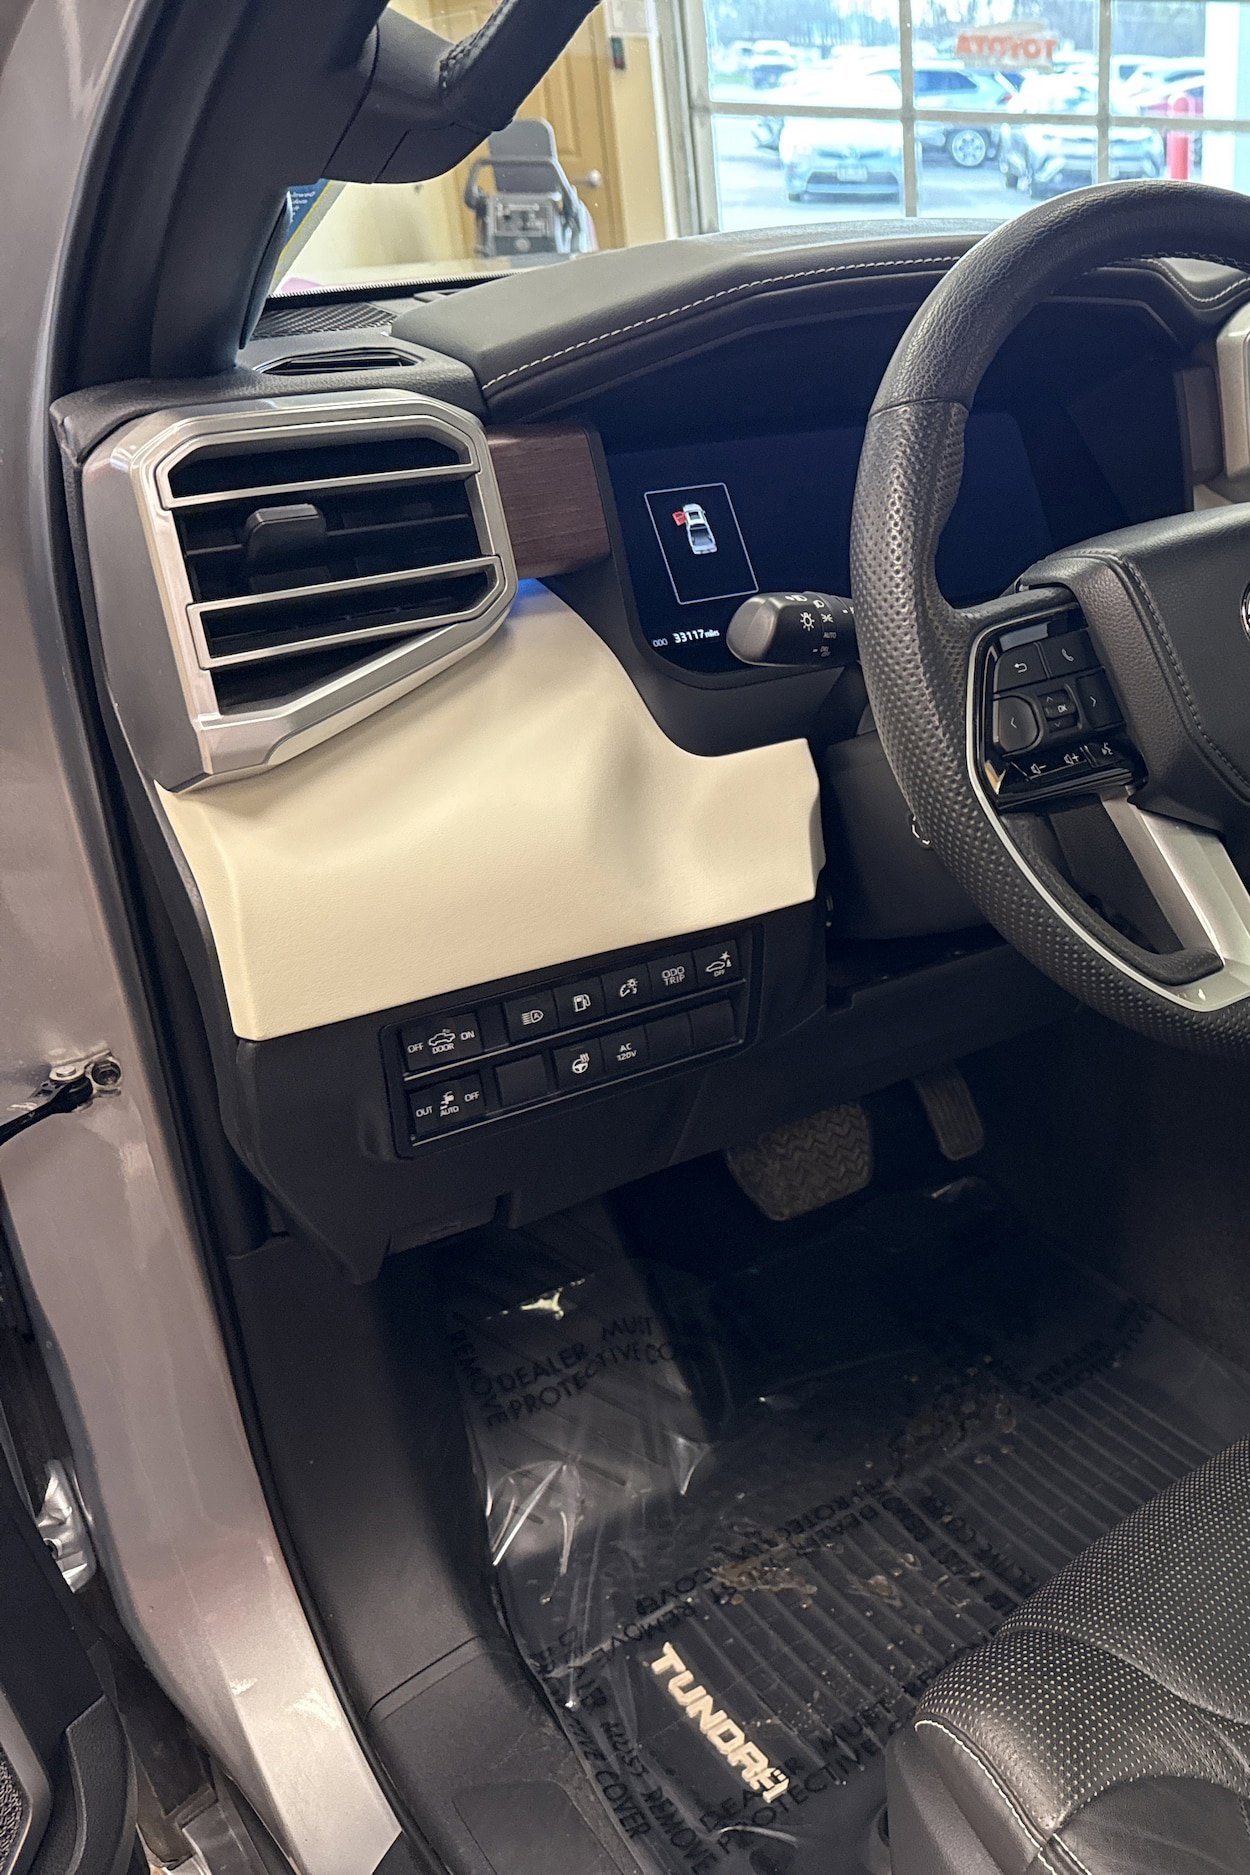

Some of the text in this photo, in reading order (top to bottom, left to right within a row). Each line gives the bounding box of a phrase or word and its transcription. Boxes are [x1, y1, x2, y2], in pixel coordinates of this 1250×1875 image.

[652, 638, 668, 648] ODO
[662, 966, 685, 980] ODO
[664, 974, 686, 986] TRIP
[460, 1030, 475, 1041] ON
[408, 1041, 424, 1053] OFF
[432, 1042, 455, 1054] DOOR
[620, 1043, 632, 1052] AC
[616, 1050, 637, 1062] 120V
[464, 1091, 480, 1102] OFF
[416, 1106, 432, 1118] OUT
[440, 1105, 460, 1117] AUTO
[497, 1342, 588, 1392] DEALER
[653, 1640, 790, 1803] TUNDRA
[716, 1737, 878, 1854] POTECTIVE
[593, 1763, 652, 1841] COVER
